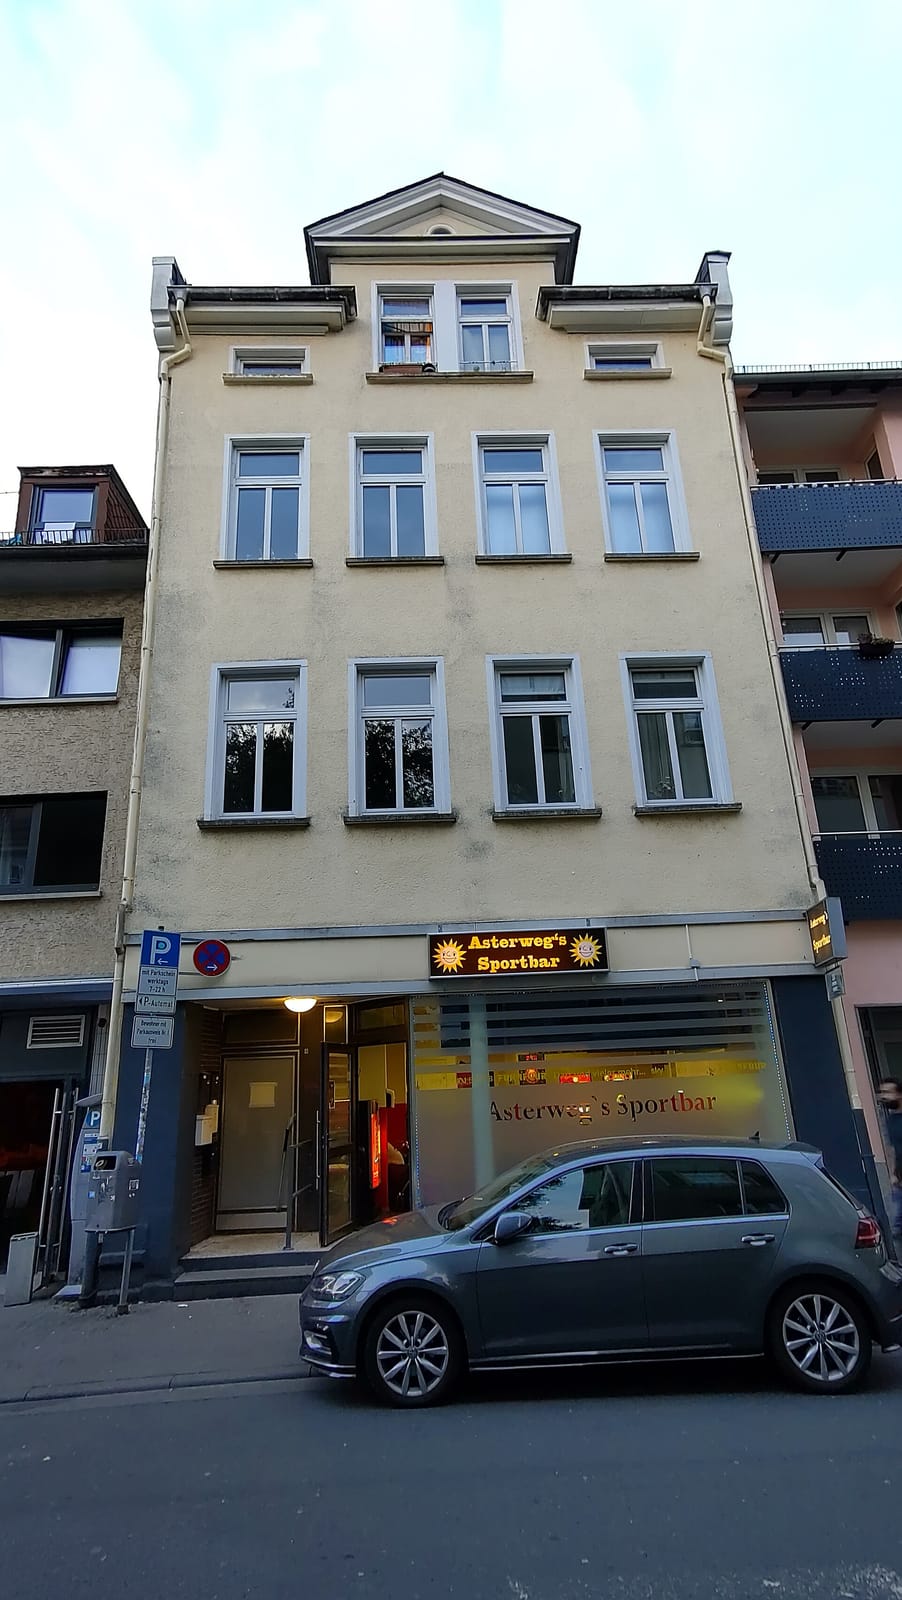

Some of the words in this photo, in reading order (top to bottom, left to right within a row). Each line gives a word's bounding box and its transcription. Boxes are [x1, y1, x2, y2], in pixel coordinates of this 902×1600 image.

[149, 935, 171, 965] P
[812, 934, 831, 954] Sportbar
[477, 955, 560, 973] Sportbar
[143, 996, 173, 1008] P-Automat
[616, 1089, 717, 1123] Sportbar
[90, 1110, 101, 1126] P
